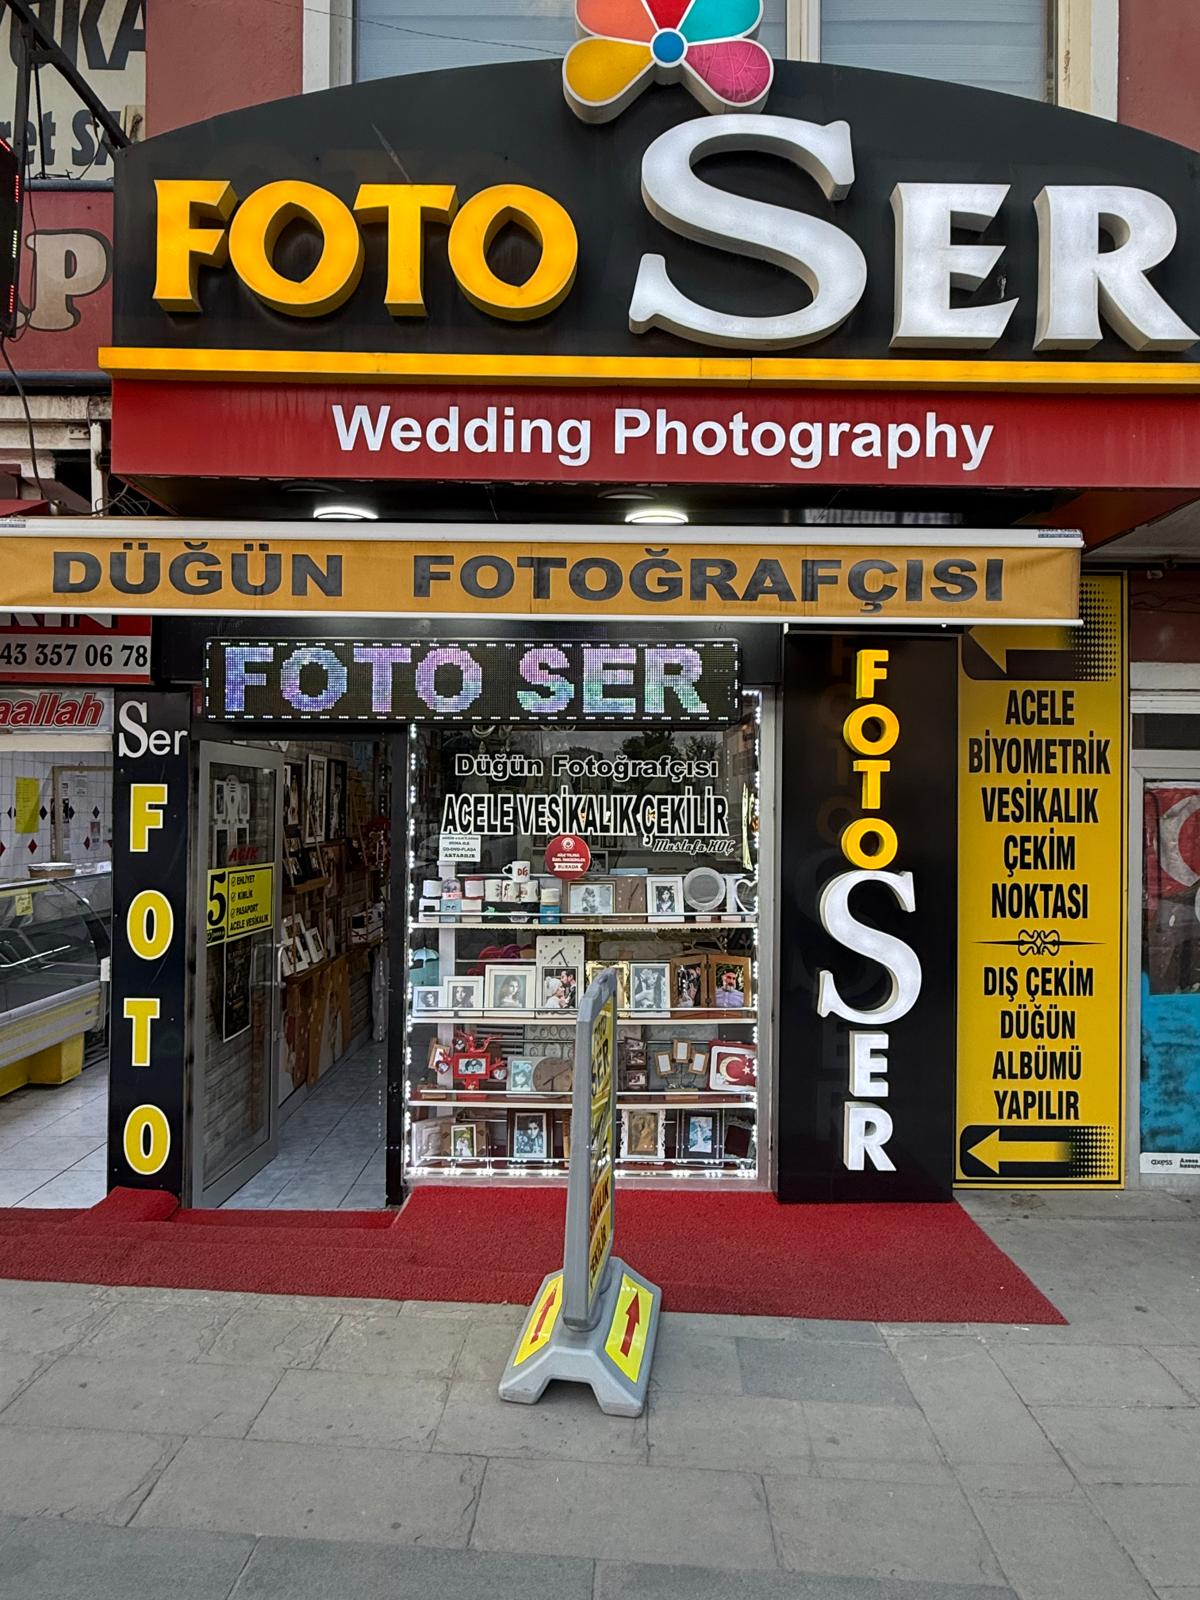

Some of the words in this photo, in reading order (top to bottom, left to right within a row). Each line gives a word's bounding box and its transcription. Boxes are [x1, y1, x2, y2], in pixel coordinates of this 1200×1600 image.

[152, 179, 579, 320] FOTO
[628, 113, 1200, 352] SER
[331, 404, 592, 467] Wedding
[613, 408, 994, 472] Photography
[52, 541, 343, 597] DÜĞÜN
[413, 544, 1004, 613] FOTOĞRAFÇISI
[35, 644, 77, 666] 357
[85, 644, 113, 667] 06
[120, 644, 148, 667] 78
[224, 646, 484, 714] FOTO
[516, 647, 709, 715] SER
[118, 700, 189, 759] Ser
[1005, 688, 1076, 726] ACELE
[455, 753, 544, 782] Düğün
[551, 754, 719, 783] Fotoğrafçısı
[841, 649, 900, 870] FOTO
[968, 729, 1112, 775] BİYOMETRİK
[440, 793, 514, 835] ACELE
[516, 785, 638, 837] VESİKALIK
[640, 785, 730, 847] ÇEKİLİR
[981, 778, 1100, 824] VESİKALIK
[652, 838, 706, 856] Mustafa
[1003, 827, 1076, 876] ÇEKİM
[207, 870, 227, 927] 5
[990, 882, 1089, 920] NOKTASI
[123, 782, 175, 1176] FOTO
[983, 966, 1019, 1002] DIŞ
[1026, 960, 1094, 1002] ÇEKİM
[816, 869, 923, 1172] SER
[1000, 1003, 1077, 1041] DÜĞÜN
[992, 1042, 1082, 1081] ALBÜMÜ
[994, 1089, 1080, 1121] YAPILIR
